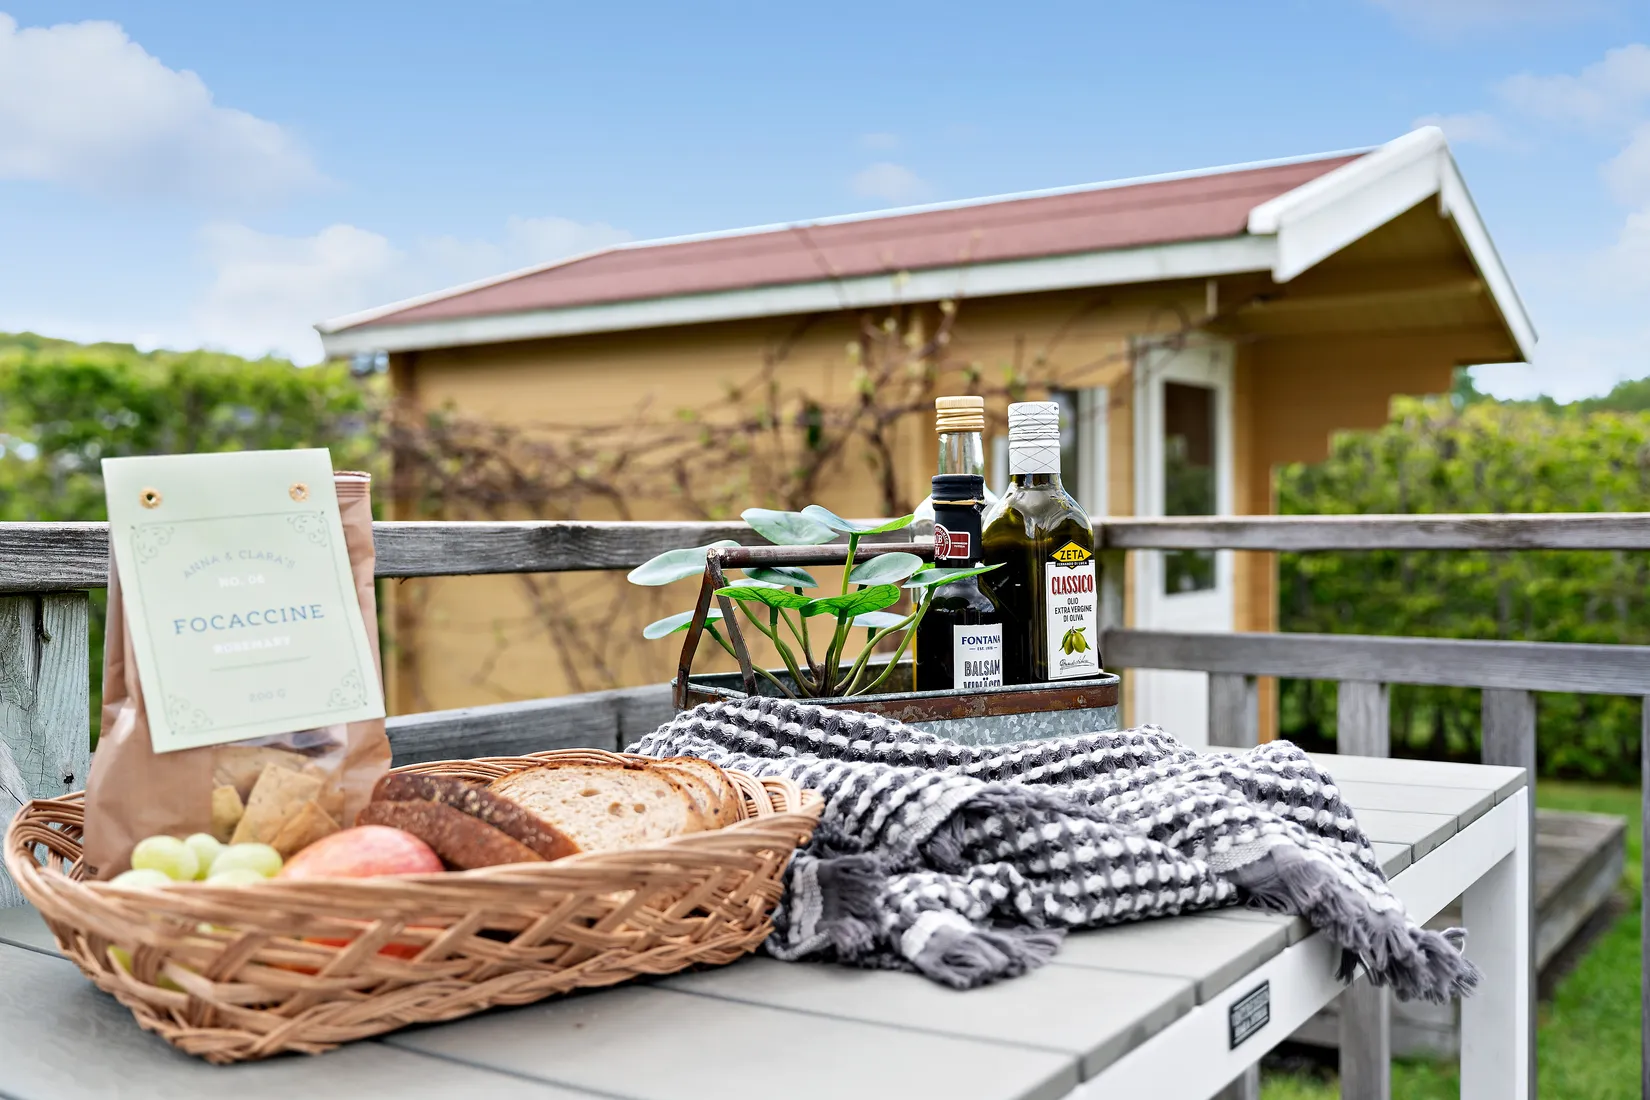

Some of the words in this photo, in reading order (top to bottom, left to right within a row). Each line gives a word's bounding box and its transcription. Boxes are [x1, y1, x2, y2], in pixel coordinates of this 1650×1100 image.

[1060, 549, 1084, 560] ZETA
[183, 555, 220, 579] ANNA
[1051, 574, 1093, 595] CLASSICO
[1067, 597, 1079, 605] OLIO
[1055, 606, 1071, 615] EXTRA
[1070, 604, 1092, 613] VERGINE
[173, 603, 325, 635] FOCACCINE
[1070, 614, 1084, 622] OLIVA
[964, 659, 1000, 676] BALSAM
